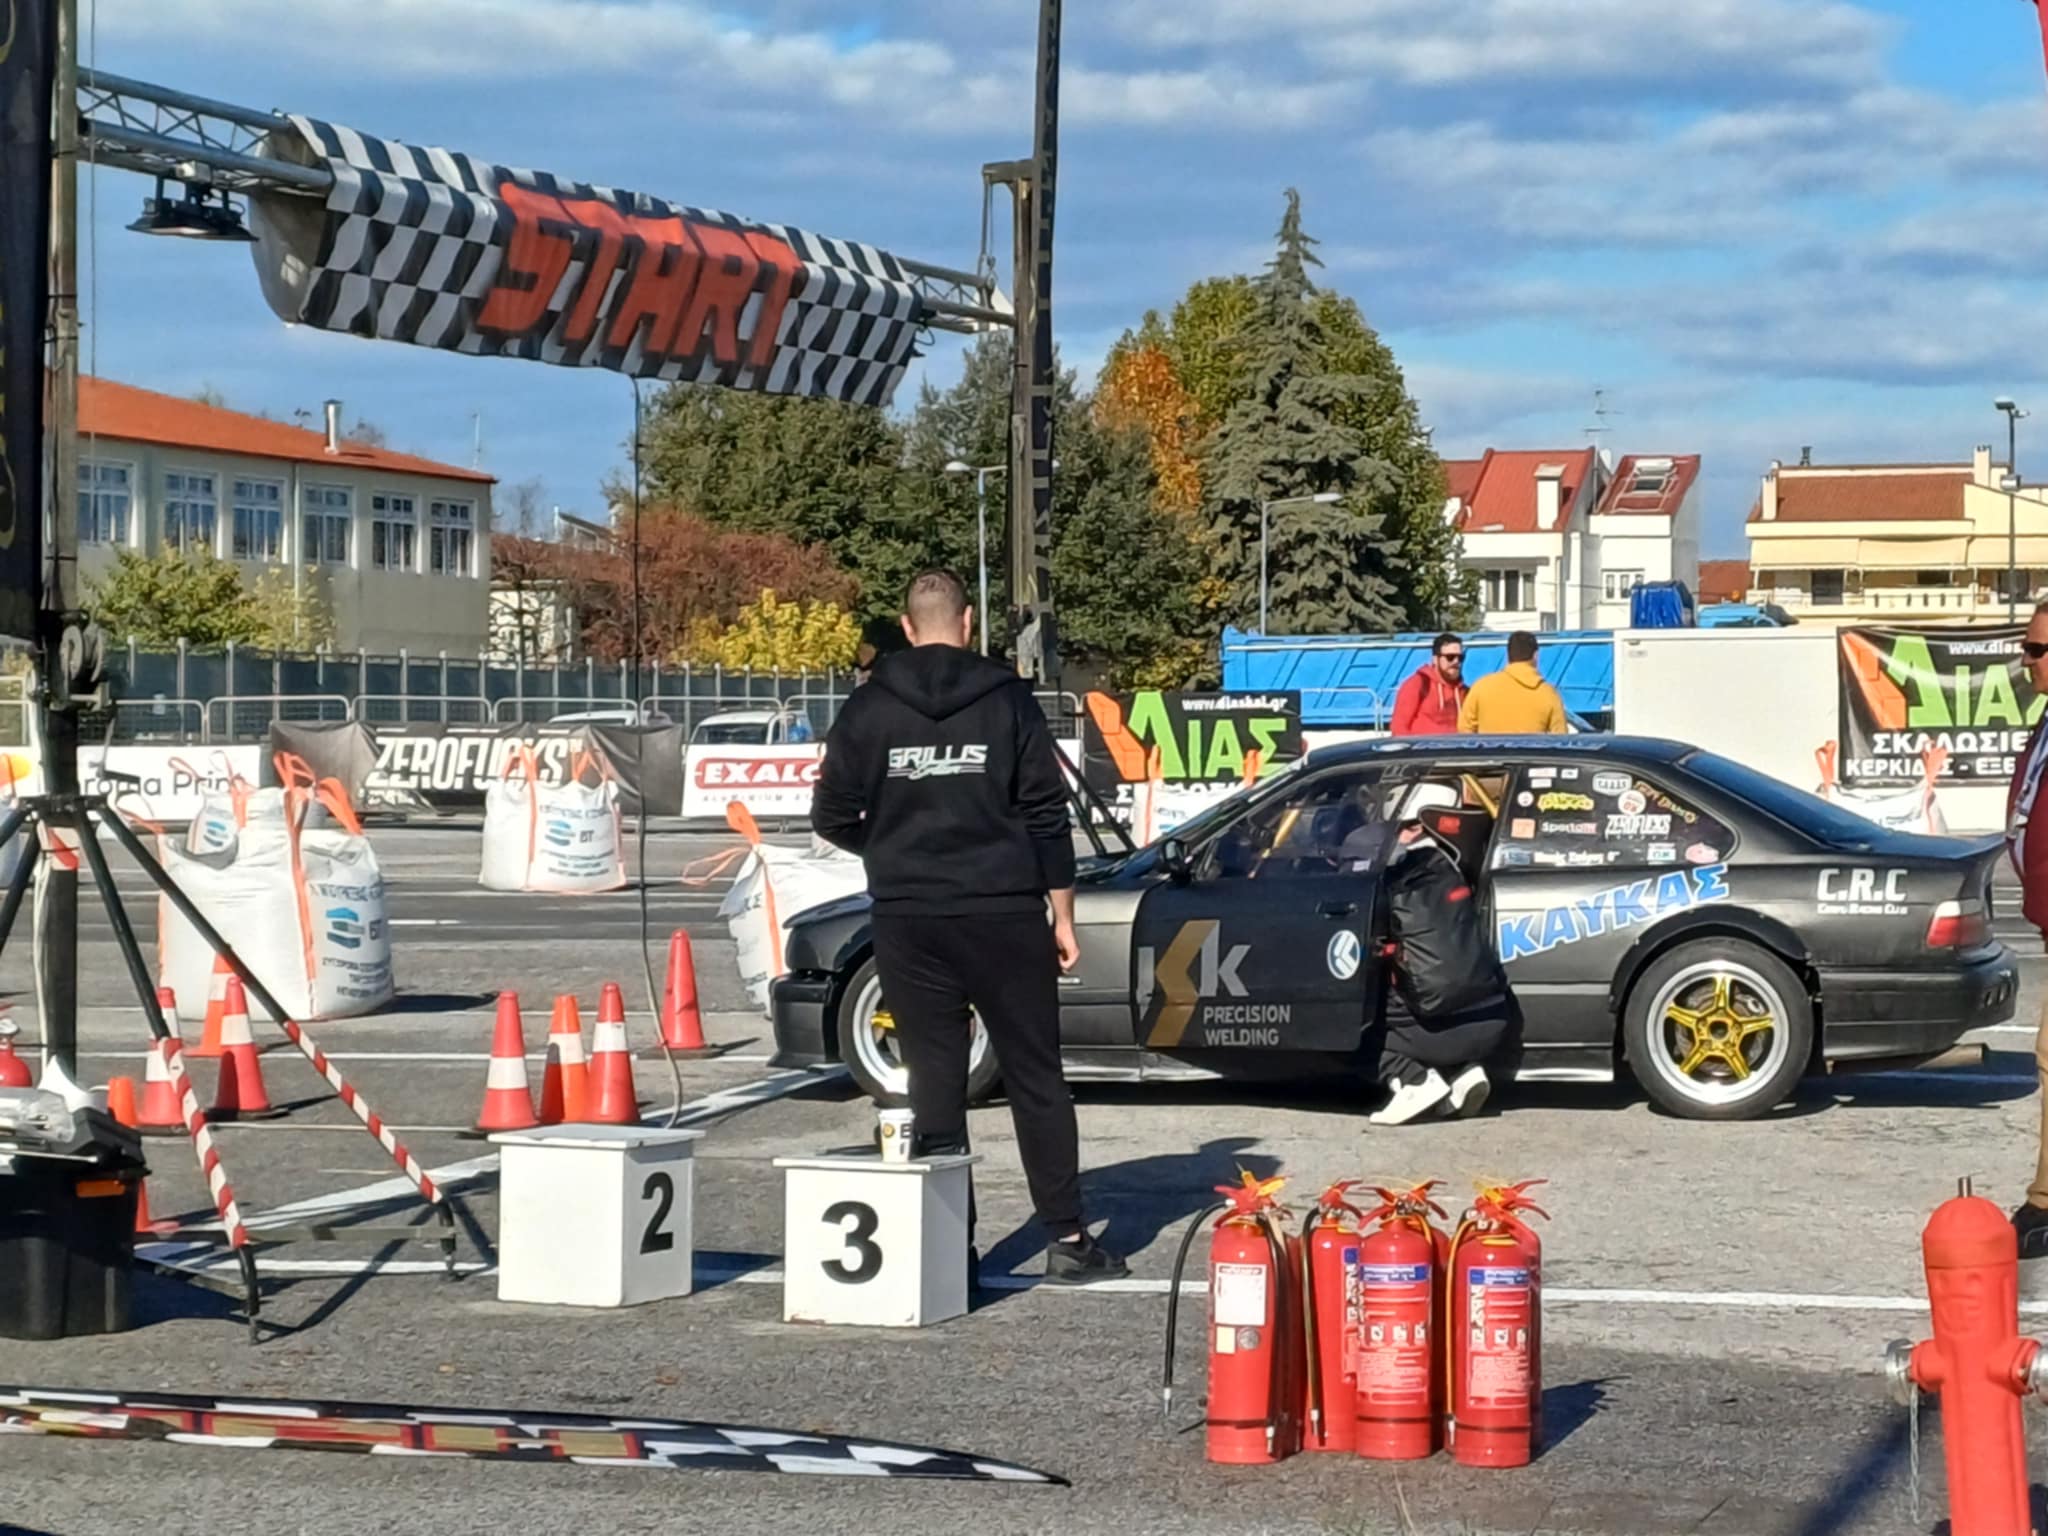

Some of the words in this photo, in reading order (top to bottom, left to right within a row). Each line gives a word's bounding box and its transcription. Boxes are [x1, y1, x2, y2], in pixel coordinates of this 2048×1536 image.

[476, 182, 804, 366] START
[1873, 732, 2035, 753] ΣΚΑΛΩΣΙΕ
[704, 761, 821, 784] EXALC
[1847, 758, 1954, 776] ΚΕΡΚΙΔΣ
[1976, 757, 2016, 775] ΕΞΕ
[84, 777, 161, 796] roma
[173, 770, 236, 796] Prin
[1498, 862, 1729, 963] ΚΑΥΚΑΣ
[1203, 1004, 1291, 1024] PRECISION
[1205, 1028, 1279, 1047] WELDING
[640, 1171, 674, 1255] 2
[820, 1200, 883, 1285] 3
